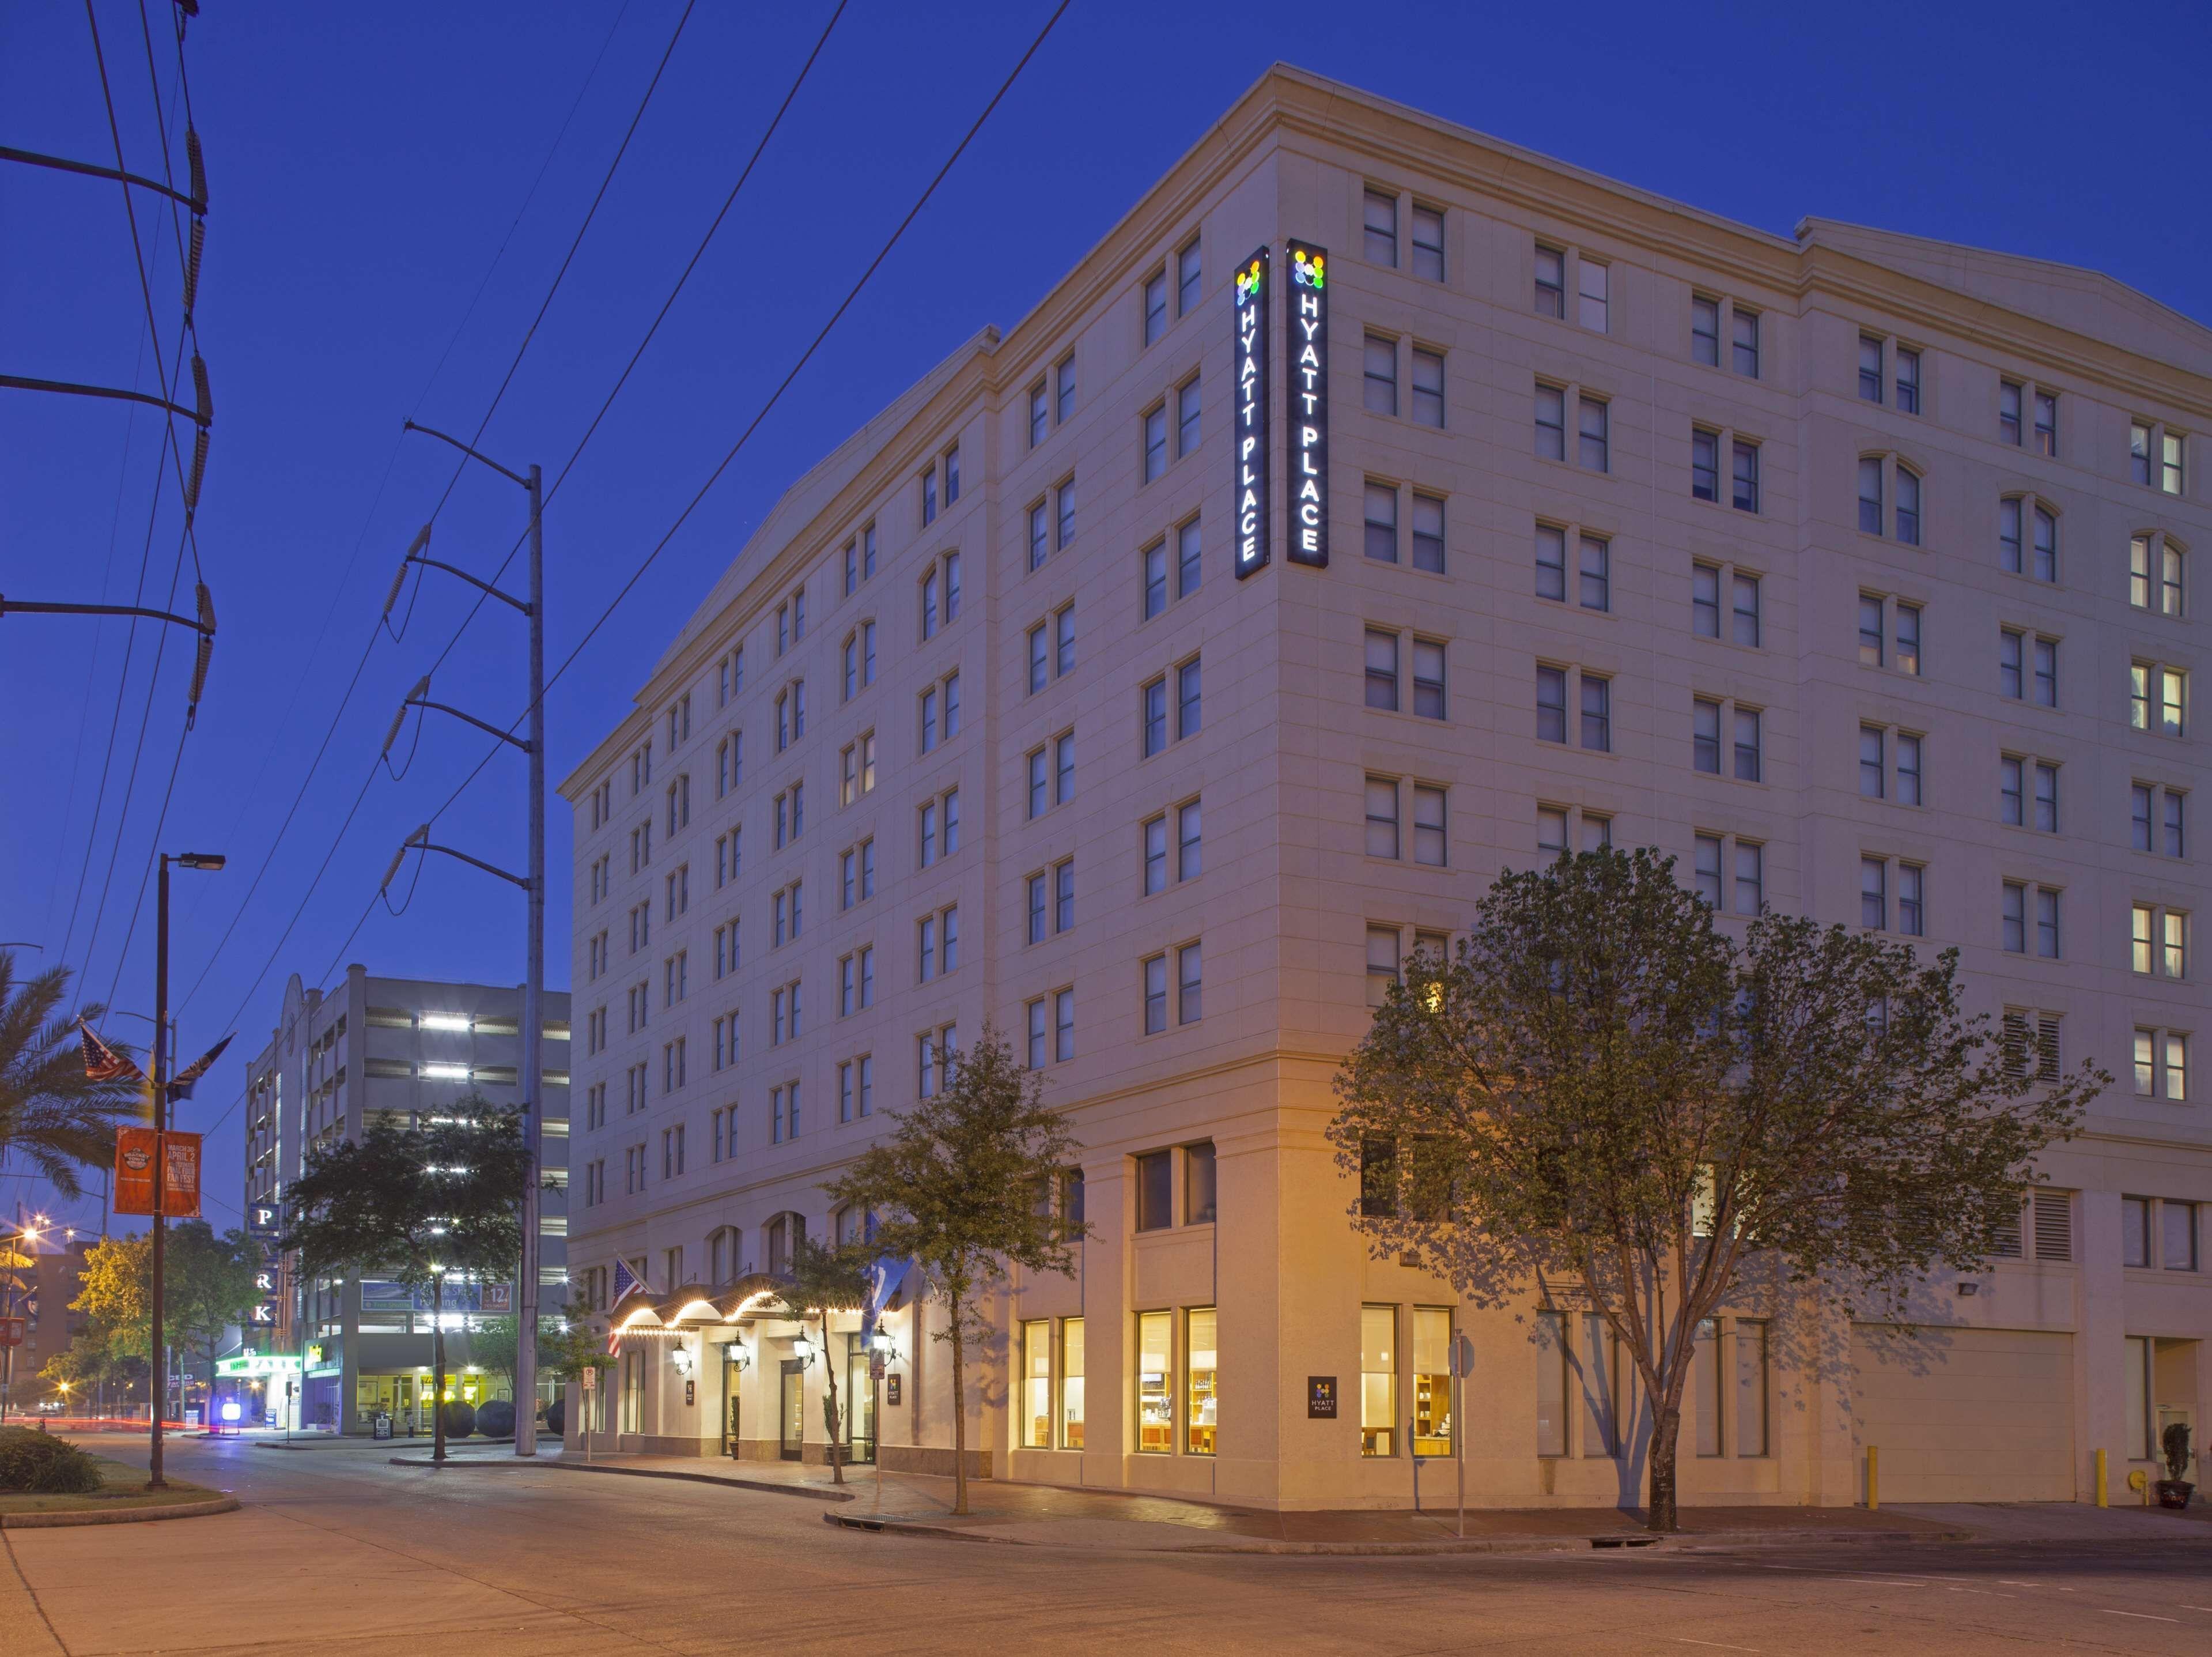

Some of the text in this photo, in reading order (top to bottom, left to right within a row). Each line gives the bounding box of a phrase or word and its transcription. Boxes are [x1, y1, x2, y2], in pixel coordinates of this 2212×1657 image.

[1241, 305, 1256, 563] HYATT PLACE
[1300, 294, 1319, 552] HYATT PLACE
[167, 1173, 194, 1183] FAN FEST
[168, 1151, 195, 1161] APRIL 2
[255, 1210, 273, 1321] PARK
